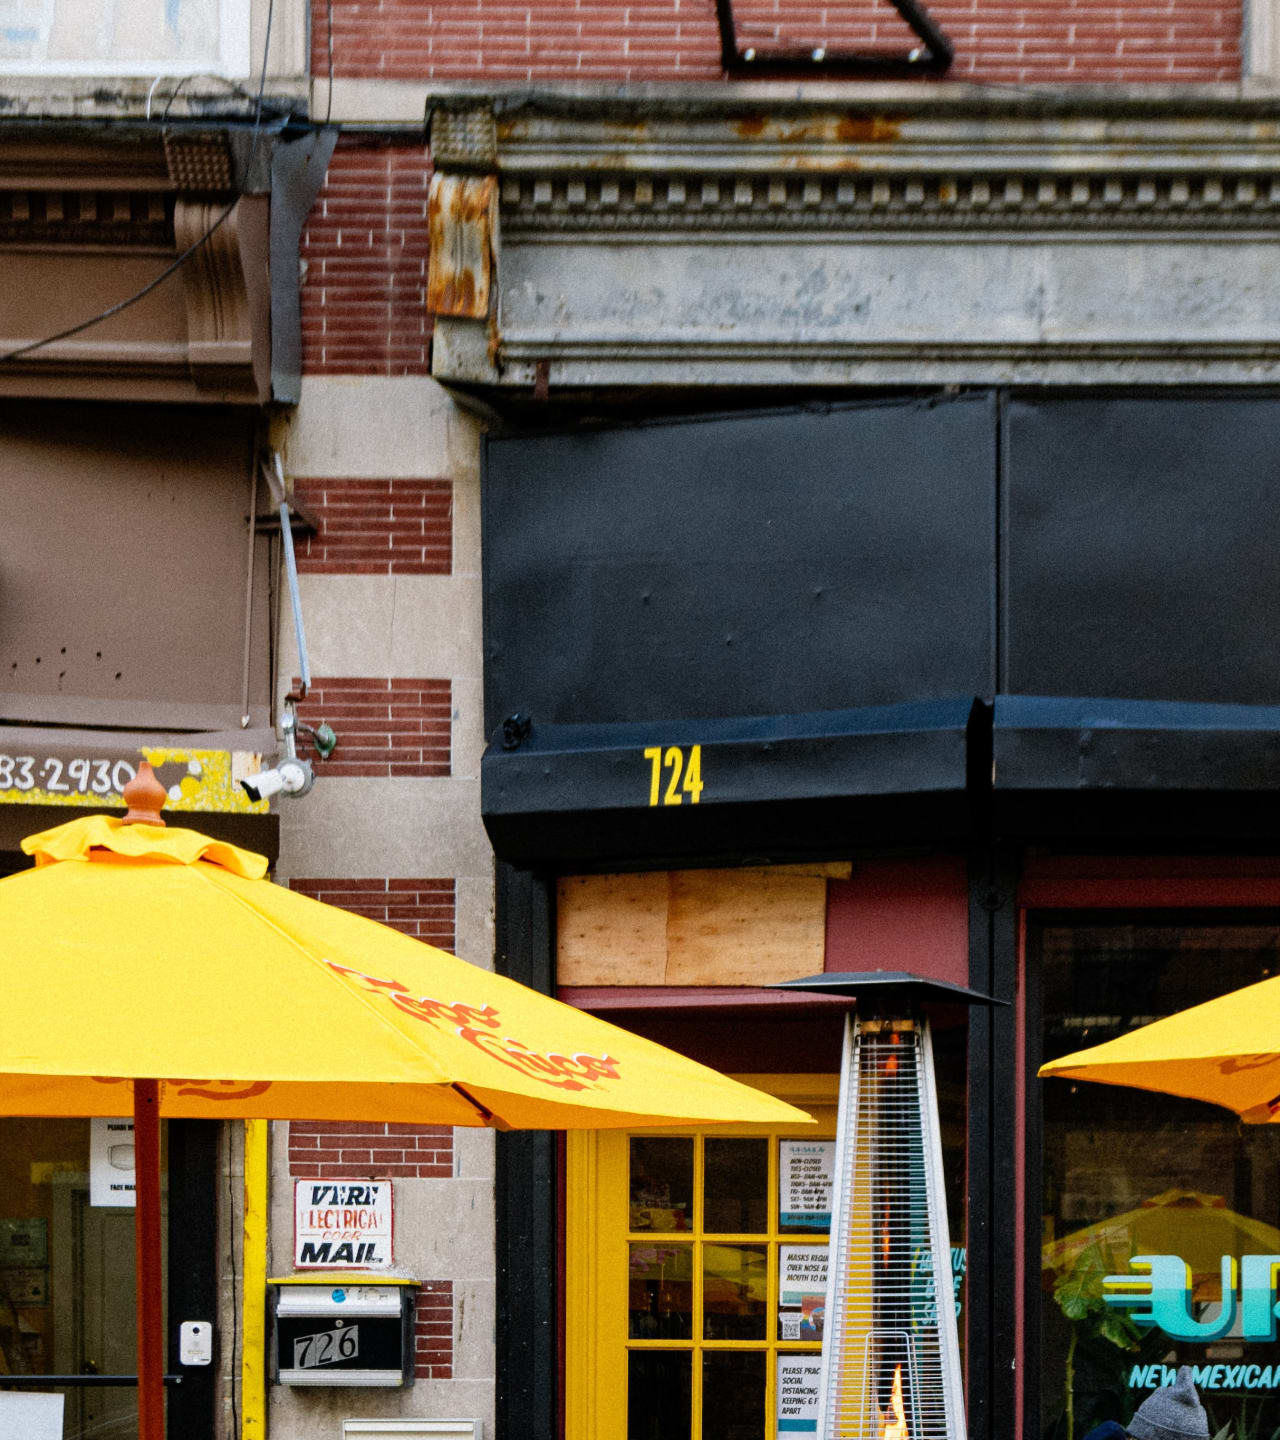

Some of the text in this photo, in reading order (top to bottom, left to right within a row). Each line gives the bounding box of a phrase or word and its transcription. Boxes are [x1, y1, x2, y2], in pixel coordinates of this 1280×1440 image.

[644, 744, 704, 807] 724
[311, 1185, 379, 1206] VERE
[300, 1242, 384, 1264] MAIL
[787, 1253, 810, 1262] MASKS
[787, 1264, 803, 1272] OVER
[803, 1264, 820, 1272] NOSE
[786, 1274, 809, 1282] MOUTH
[810, 1274, 819, 1282] TO
[295, 1327, 357, 1368] 726
[782, 1367, 803, 1375] PLEASE
[782, 1377, 803, 1385] SOCIAL
[781, 1387, 818, 1395] DISTANCING
[781, 1397, 807, 1405] KEEPING
[781, 1407, 801, 1415] APART
